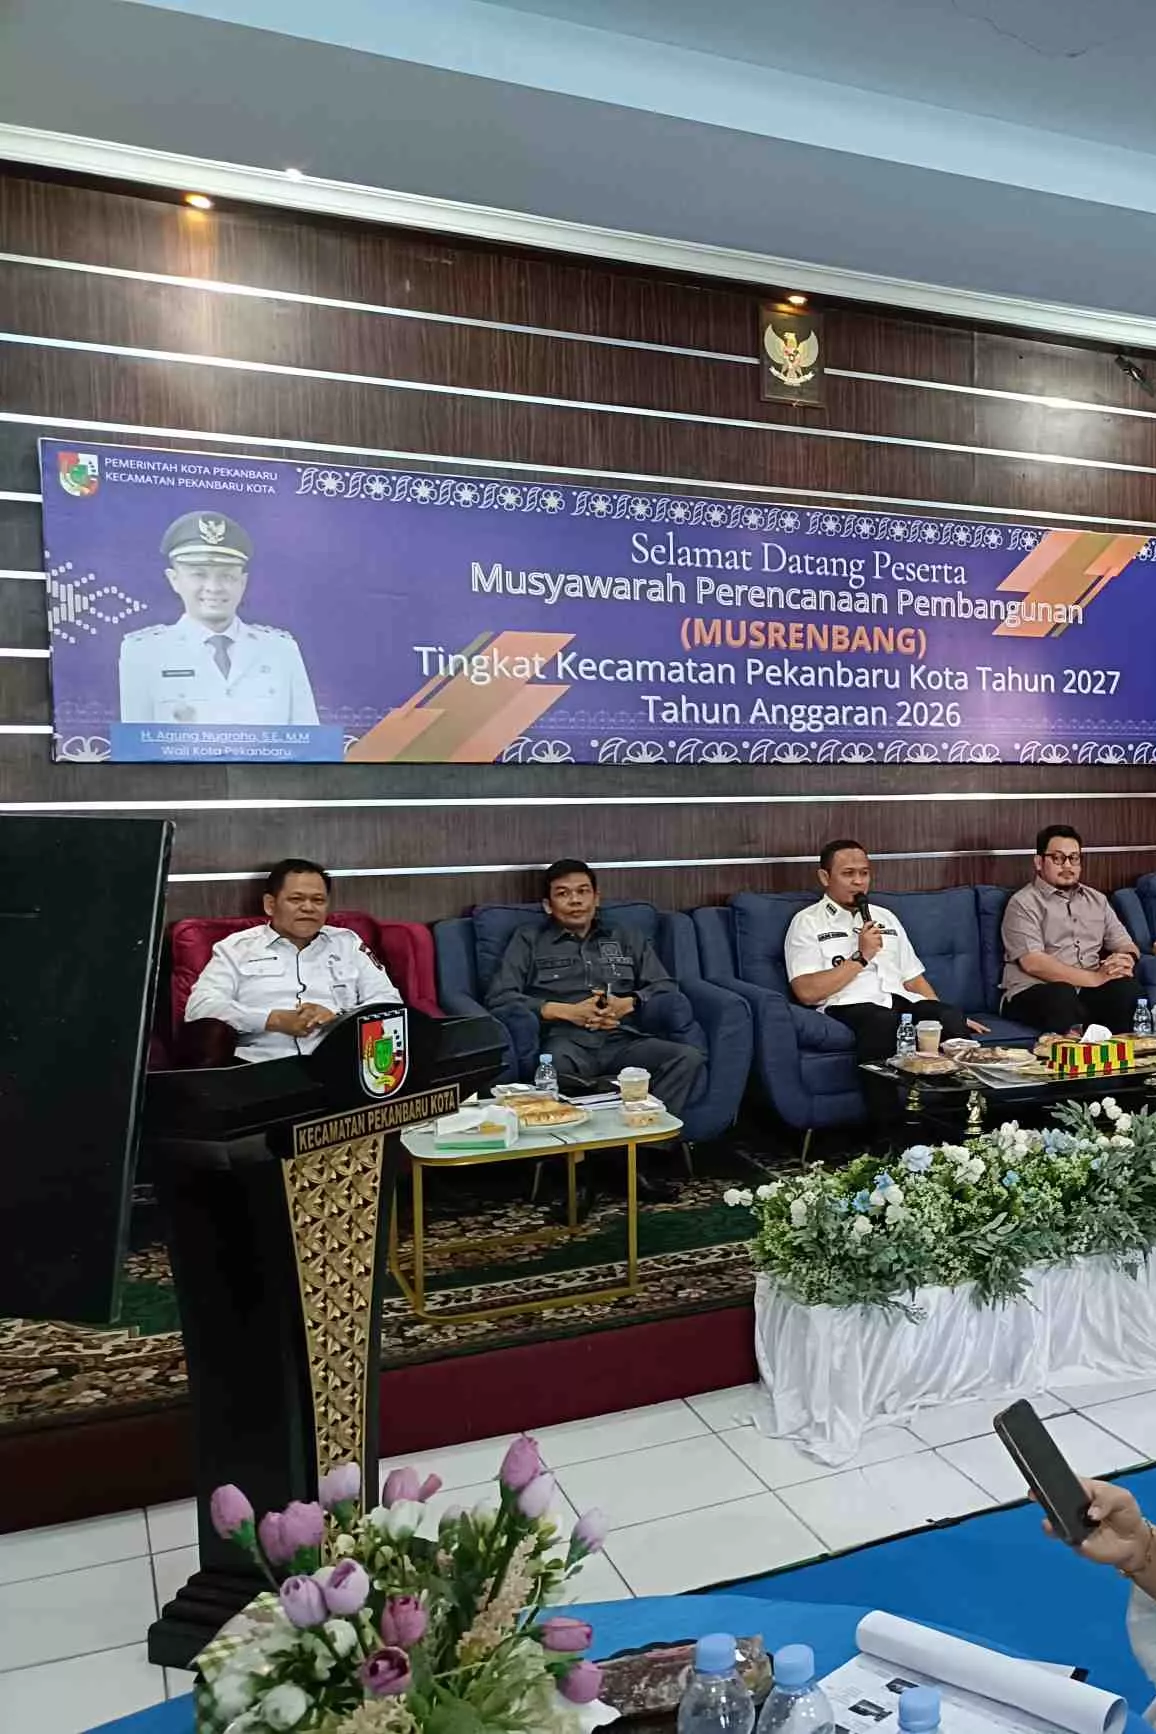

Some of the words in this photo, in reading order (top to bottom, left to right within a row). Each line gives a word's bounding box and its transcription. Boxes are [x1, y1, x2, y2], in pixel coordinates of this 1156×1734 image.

[105, 458, 178, 473] PEMERINTAH
[181, 465, 210, 475] KOTA
[213, 467, 278, 481] PEKANBARU
[106, 472, 175, 487] KECAMATAN
[178, 478, 244, 491] PEKANBARU
[246, 484, 276, 494] KOTA
[631, 532, 752, 571] Selamat
[761, 542, 865, 589] Datang
[872, 550, 968, 585] Peserta
[471, 562, 686, 604] Musyawarah
[696, 576, 888, 615] Perencanaan
[897, 588, 1084, 628] Pembangunan
[680, 616, 928, 660] (MUSRENBANG)
[413, 646, 546, 685] Tingkat
[557, 651, 736, 685] Kecamatan
[746, 658, 900, 690] Pekanbaru
[910, 664, 969, 691] Kota
[976, 666, 1055, 693] Tahun
[1062, 669, 1121, 694] 2027
[641, 695, 740, 724] Tahun
[749, 698, 887, 733] Anggaran
[896, 701, 961, 727] 2026
[158, 731, 200, 742] Agung
[161, 747, 190, 756] Wali
[193, 747, 222, 756] Kota
[299, 1114, 366, 1151] KECAMATAN
[368, 1095, 428, 1131] PEKANBARU
[430, 1089, 456, 1114] KOTA
